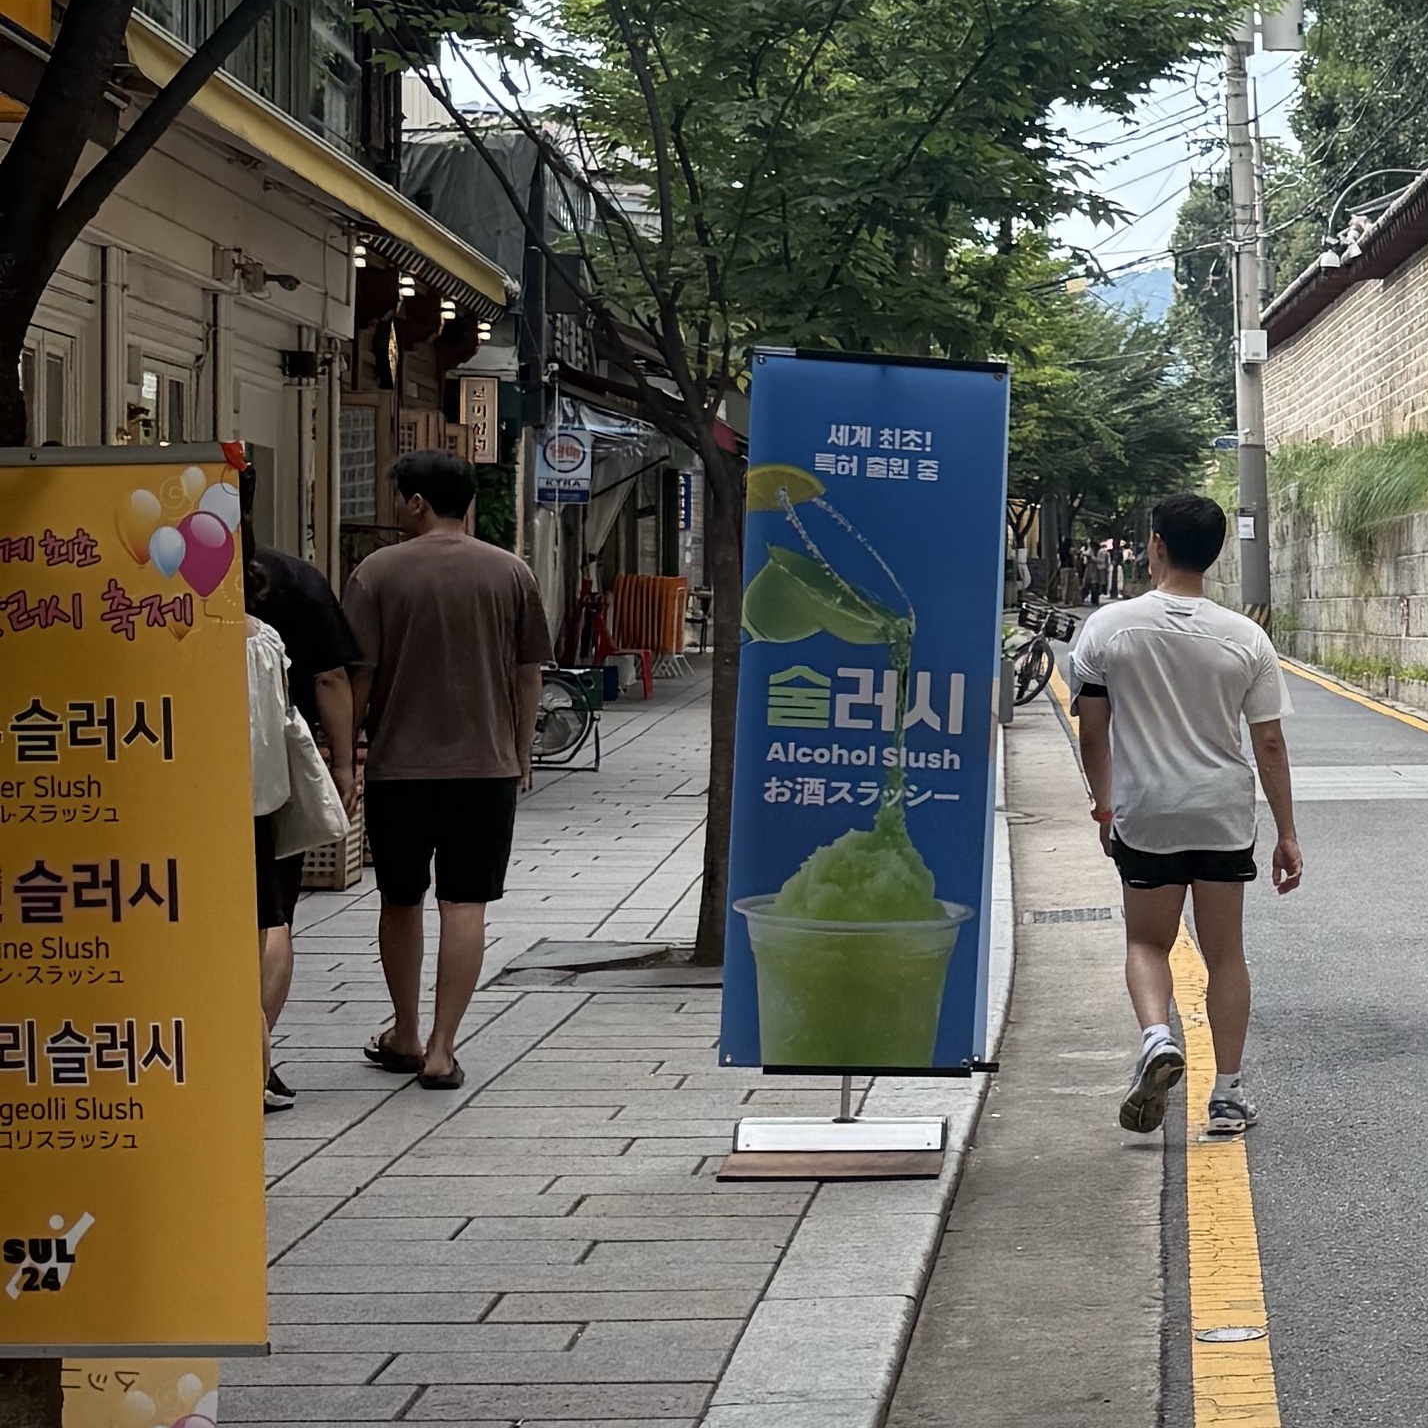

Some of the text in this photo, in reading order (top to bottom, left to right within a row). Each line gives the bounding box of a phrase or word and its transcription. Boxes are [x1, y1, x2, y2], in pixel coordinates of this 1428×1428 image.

[827, 424, 932, 452] 세계 최초!
[814, 453, 939, 481] 특허 출원 중
[39, 528, 101, 567] 최초
[0, 578, 193, 641] 러시 축제
[767, 665, 965, 734] 술러시
[0, 696, 174, 763] 슬러시
[766, 742, 960, 770] Alcohol Slush
[34, 775, 101, 798] Slush
[0, 858, 179, 924] 슬러시
[42, 936, 109, 959] Slush
[0, 1097, 143, 1126] geolli Slush
[3, 1238, 76, 1264] SUL
[22, 1266, 61, 1292] 24
